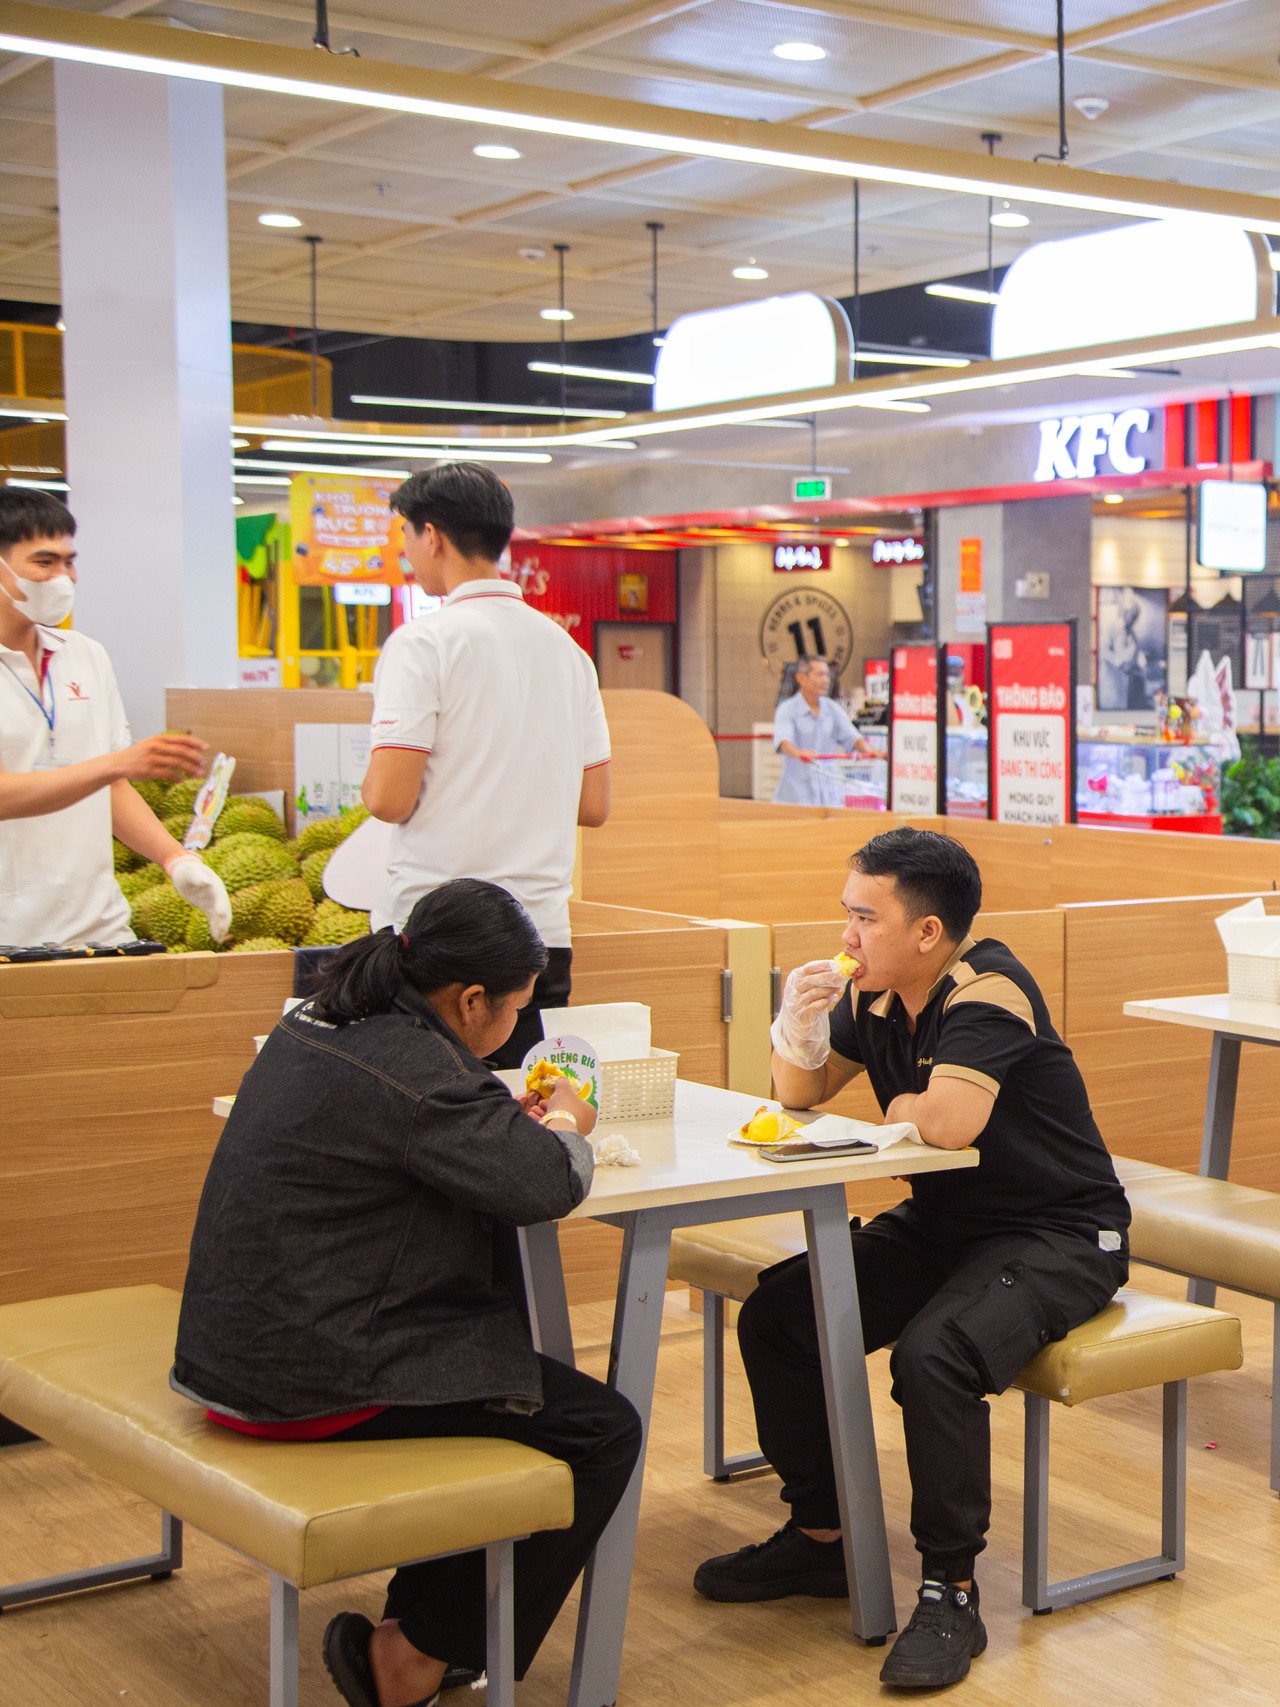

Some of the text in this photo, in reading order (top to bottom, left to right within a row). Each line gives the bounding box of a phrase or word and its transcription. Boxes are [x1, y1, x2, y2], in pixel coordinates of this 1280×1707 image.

[1033, 408, 1150, 482] KFC
[787, 617, 827, 658] 11
[996, 682, 1066, 711] THÔNG BÁO
[1013, 730, 1031, 748] KHU
[1024, 760, 1038, 778] THI
[1040, 757, 1063, 780] CÔNG
[1009, 793, 1035, 805] MONG
[550, 1050, 596, 1069] RIÊNG RI6
